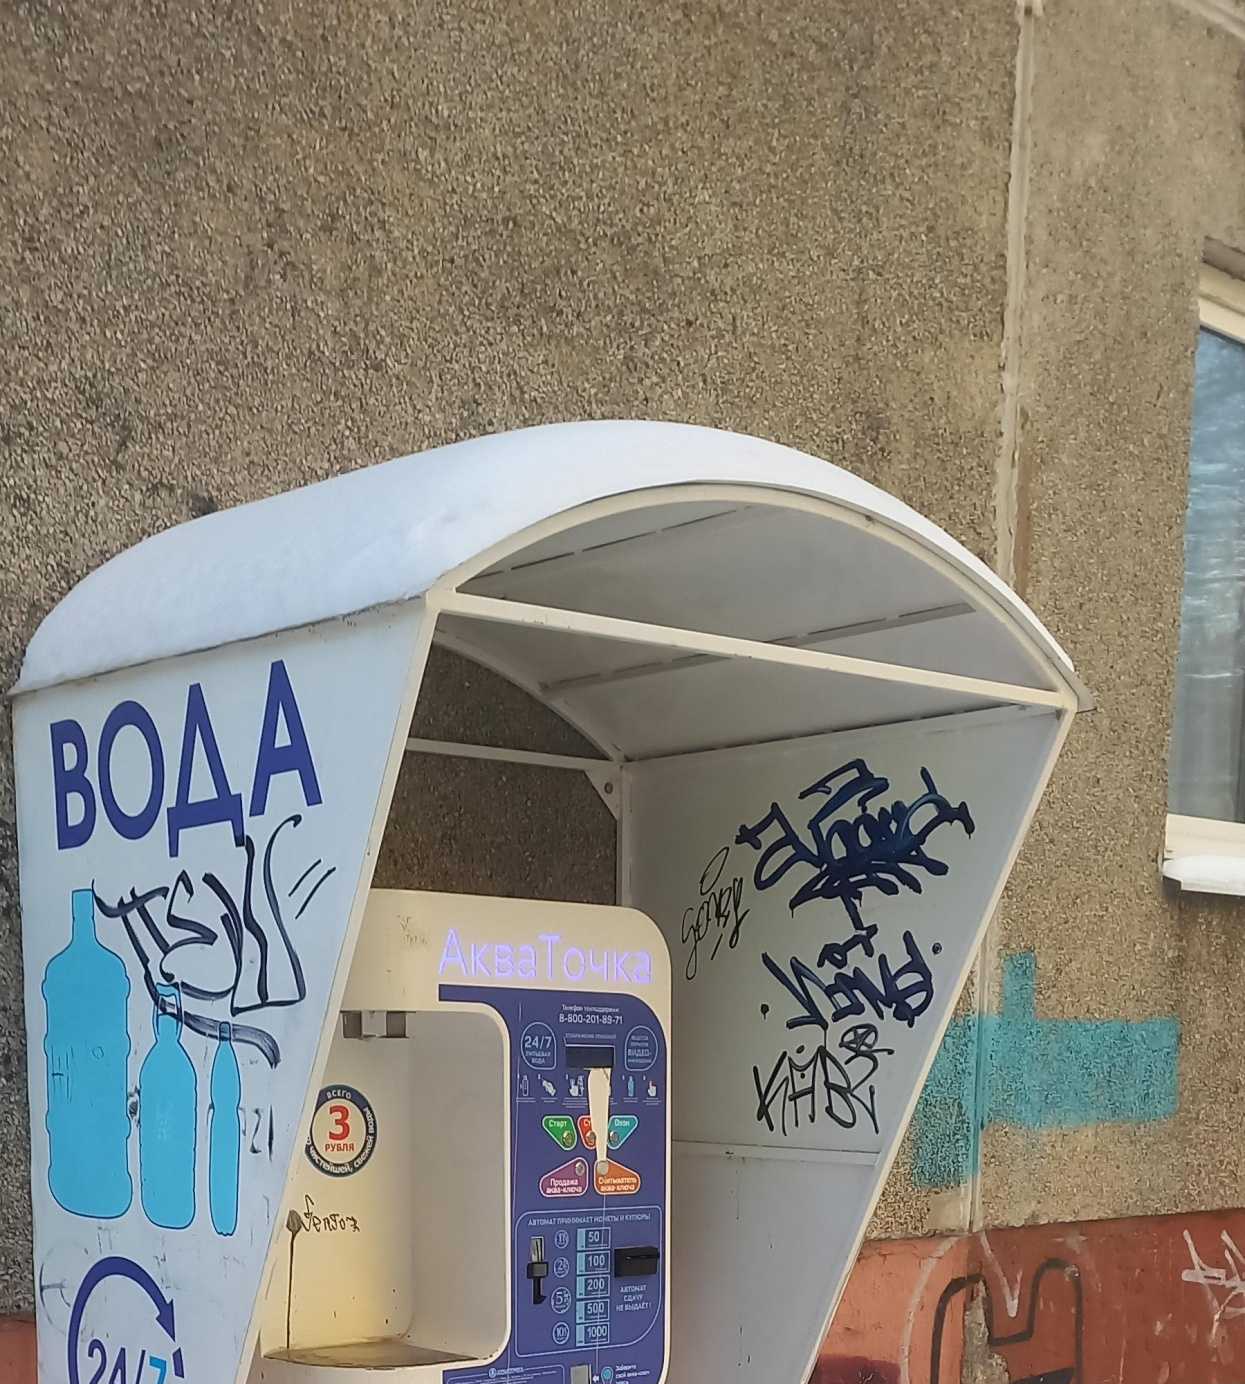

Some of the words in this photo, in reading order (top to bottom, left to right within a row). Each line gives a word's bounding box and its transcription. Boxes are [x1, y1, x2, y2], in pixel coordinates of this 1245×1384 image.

[50, 659, 323, 858] ВОДА
[438, 927, 654, 984] АкваТочка
[524, 1035, 552, 1049] 24/7
[328, 1104, 351, 1141] 3
[548, 1119, 567, 1128] Старт
[324, 1142, 355, 1153] РУБЛЯ
[588, 1231, 600, 1242] 50
[588, 1254, 606, 1267] 100
[587, 1278, 605, 1291] 200
[586, 1302, 605, 1314] 500
[586, 1325, 608, 1338] 1000
